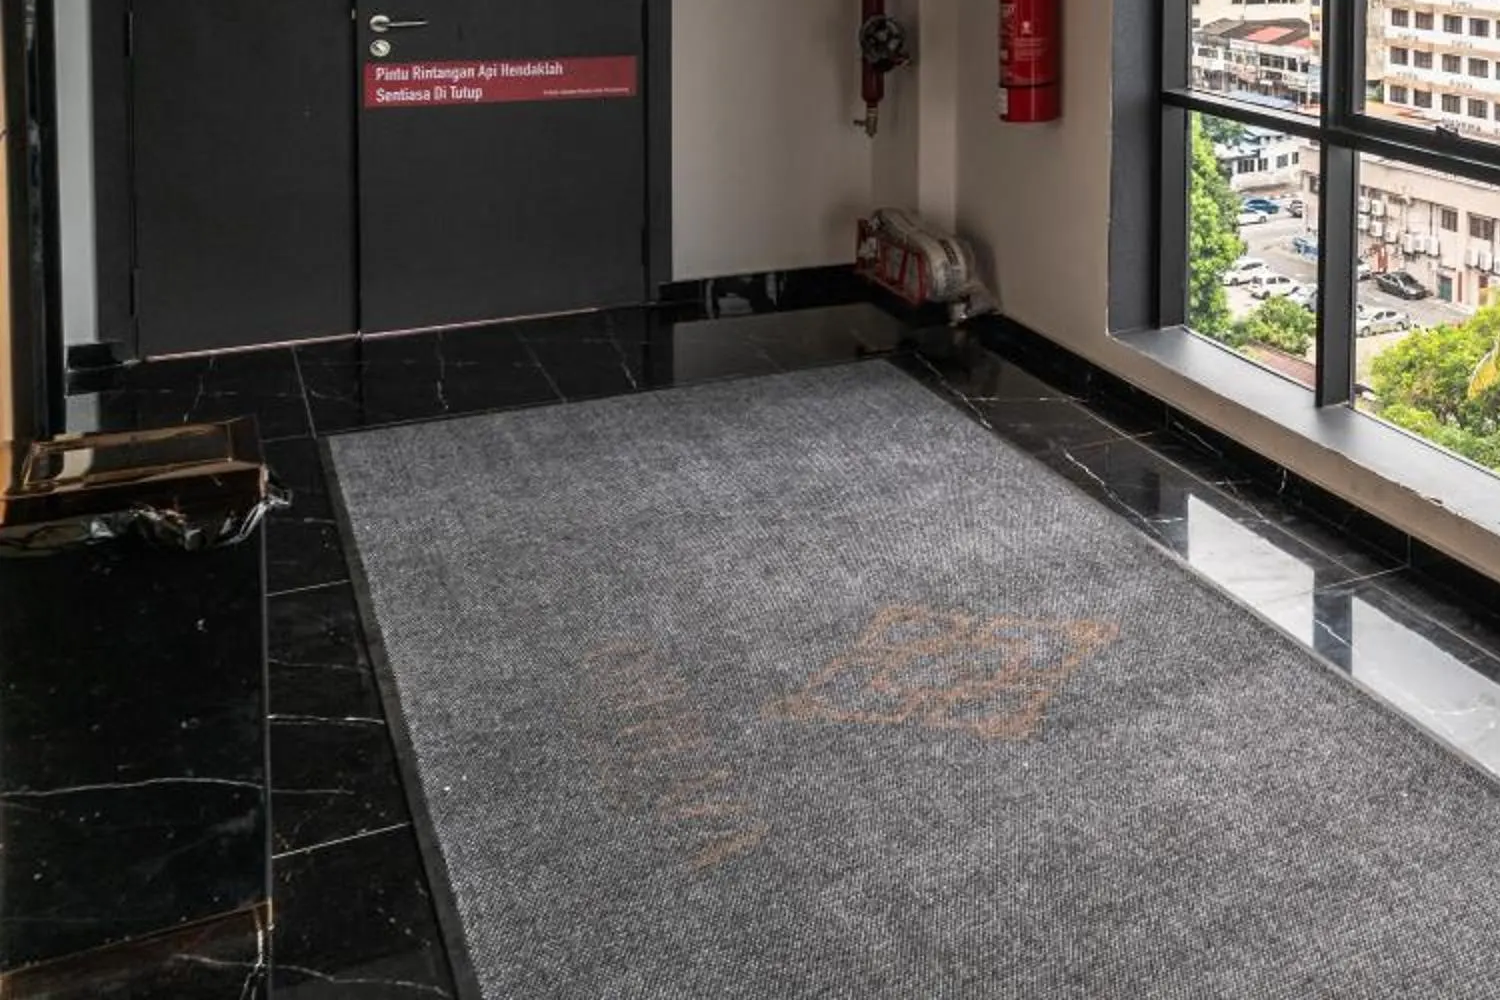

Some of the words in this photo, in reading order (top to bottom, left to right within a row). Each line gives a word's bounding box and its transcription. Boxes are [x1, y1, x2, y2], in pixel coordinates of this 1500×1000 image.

[375, 66, 409, 81] Pintu
[411, 64, 475, 83] Rintangan
[477, 63, 497, 81] Api
[501, 61, 563, 77] Hendaklah
[375, 87, 431, 104] Sentiasa
[433, 85, 447, 101] Di
[449, 84, 483, 103] Tutup
